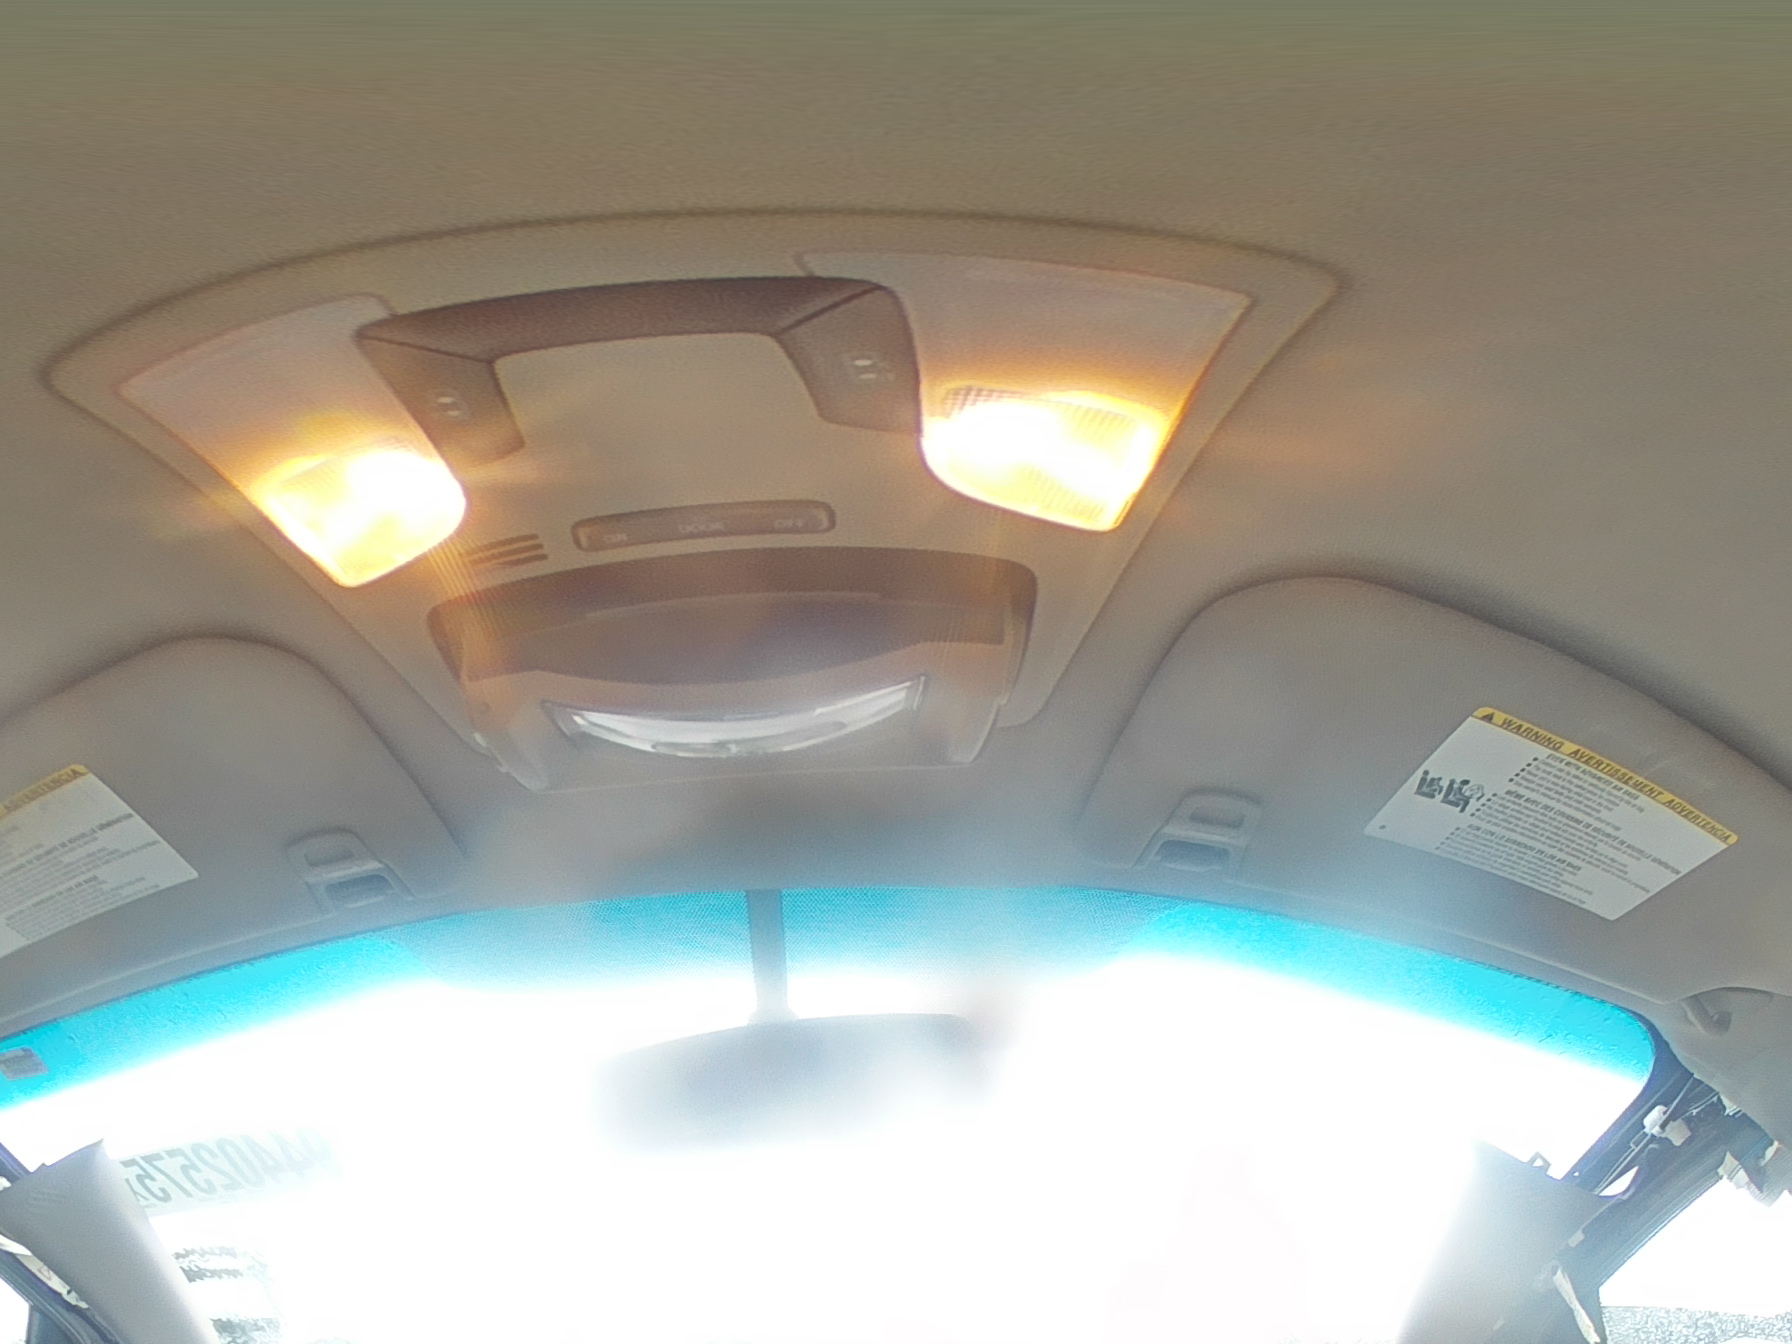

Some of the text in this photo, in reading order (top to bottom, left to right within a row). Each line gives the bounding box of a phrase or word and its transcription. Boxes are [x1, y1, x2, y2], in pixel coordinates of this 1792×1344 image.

[1501, 717, 1565, 751] WARNING
[1567, 748, 1665, 800] AVERTISSEMENT
[1663, 798, 1733, 843] ADVERTENCIA
